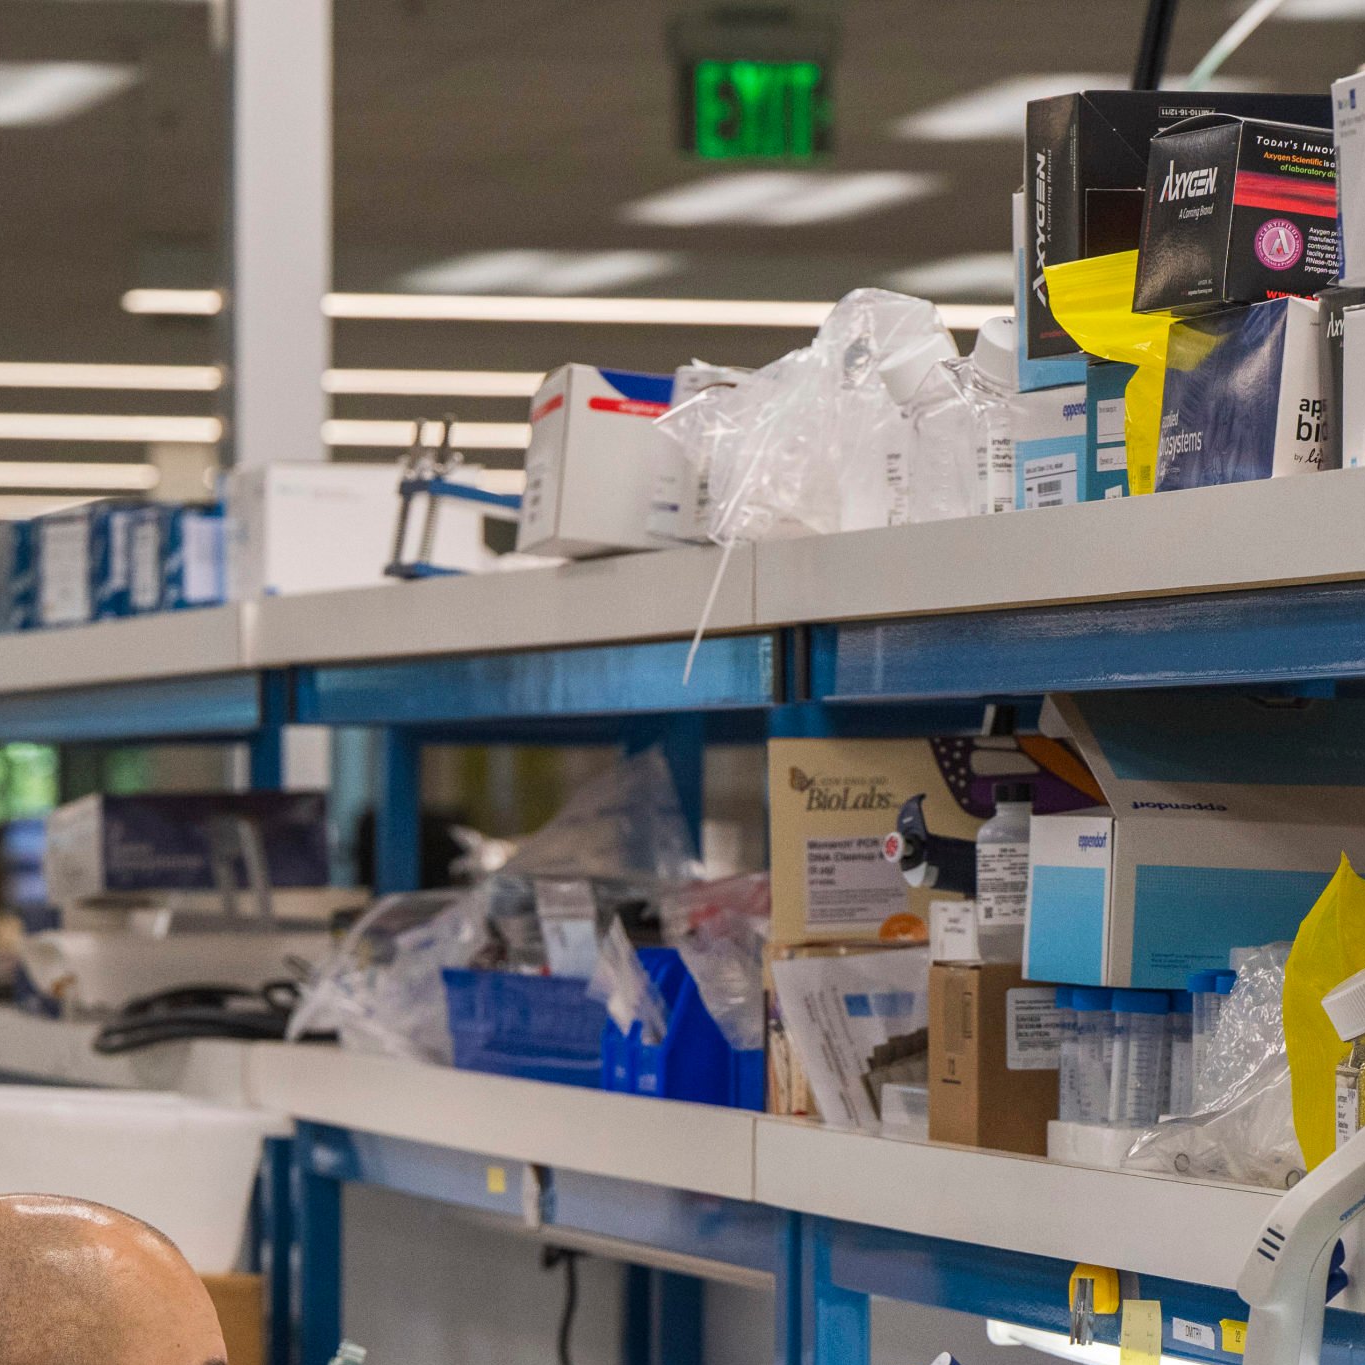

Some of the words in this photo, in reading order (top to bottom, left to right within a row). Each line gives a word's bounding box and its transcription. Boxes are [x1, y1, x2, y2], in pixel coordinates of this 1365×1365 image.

[696, 59, 822, 160] EXIT
[1256, 136, 1297, 150] TODAY'S
[1303, 142, 1337, 155] INNOV
[1264, 151, 1291, 162] Axygen
[1291, 155, 1323, 167] Scientific
[1323, 160, 1329, 168] is
[1288, 164, 1327, 179] laboratory
[1159, 160, 1217, 203] AXYGEN
[1308, 234, 1338, 245] manufactu
[1306, 257, 1338, 267] RNase-/DN
[1162, 409, 1179, 434] applied
[1159, 431, 1203, 461] biosystems
[807, 785, 892, 811] BioLabs
[1130, 800, 1227, 812] eppendorf
[1078, 832, 1108, 851] eppendorf
